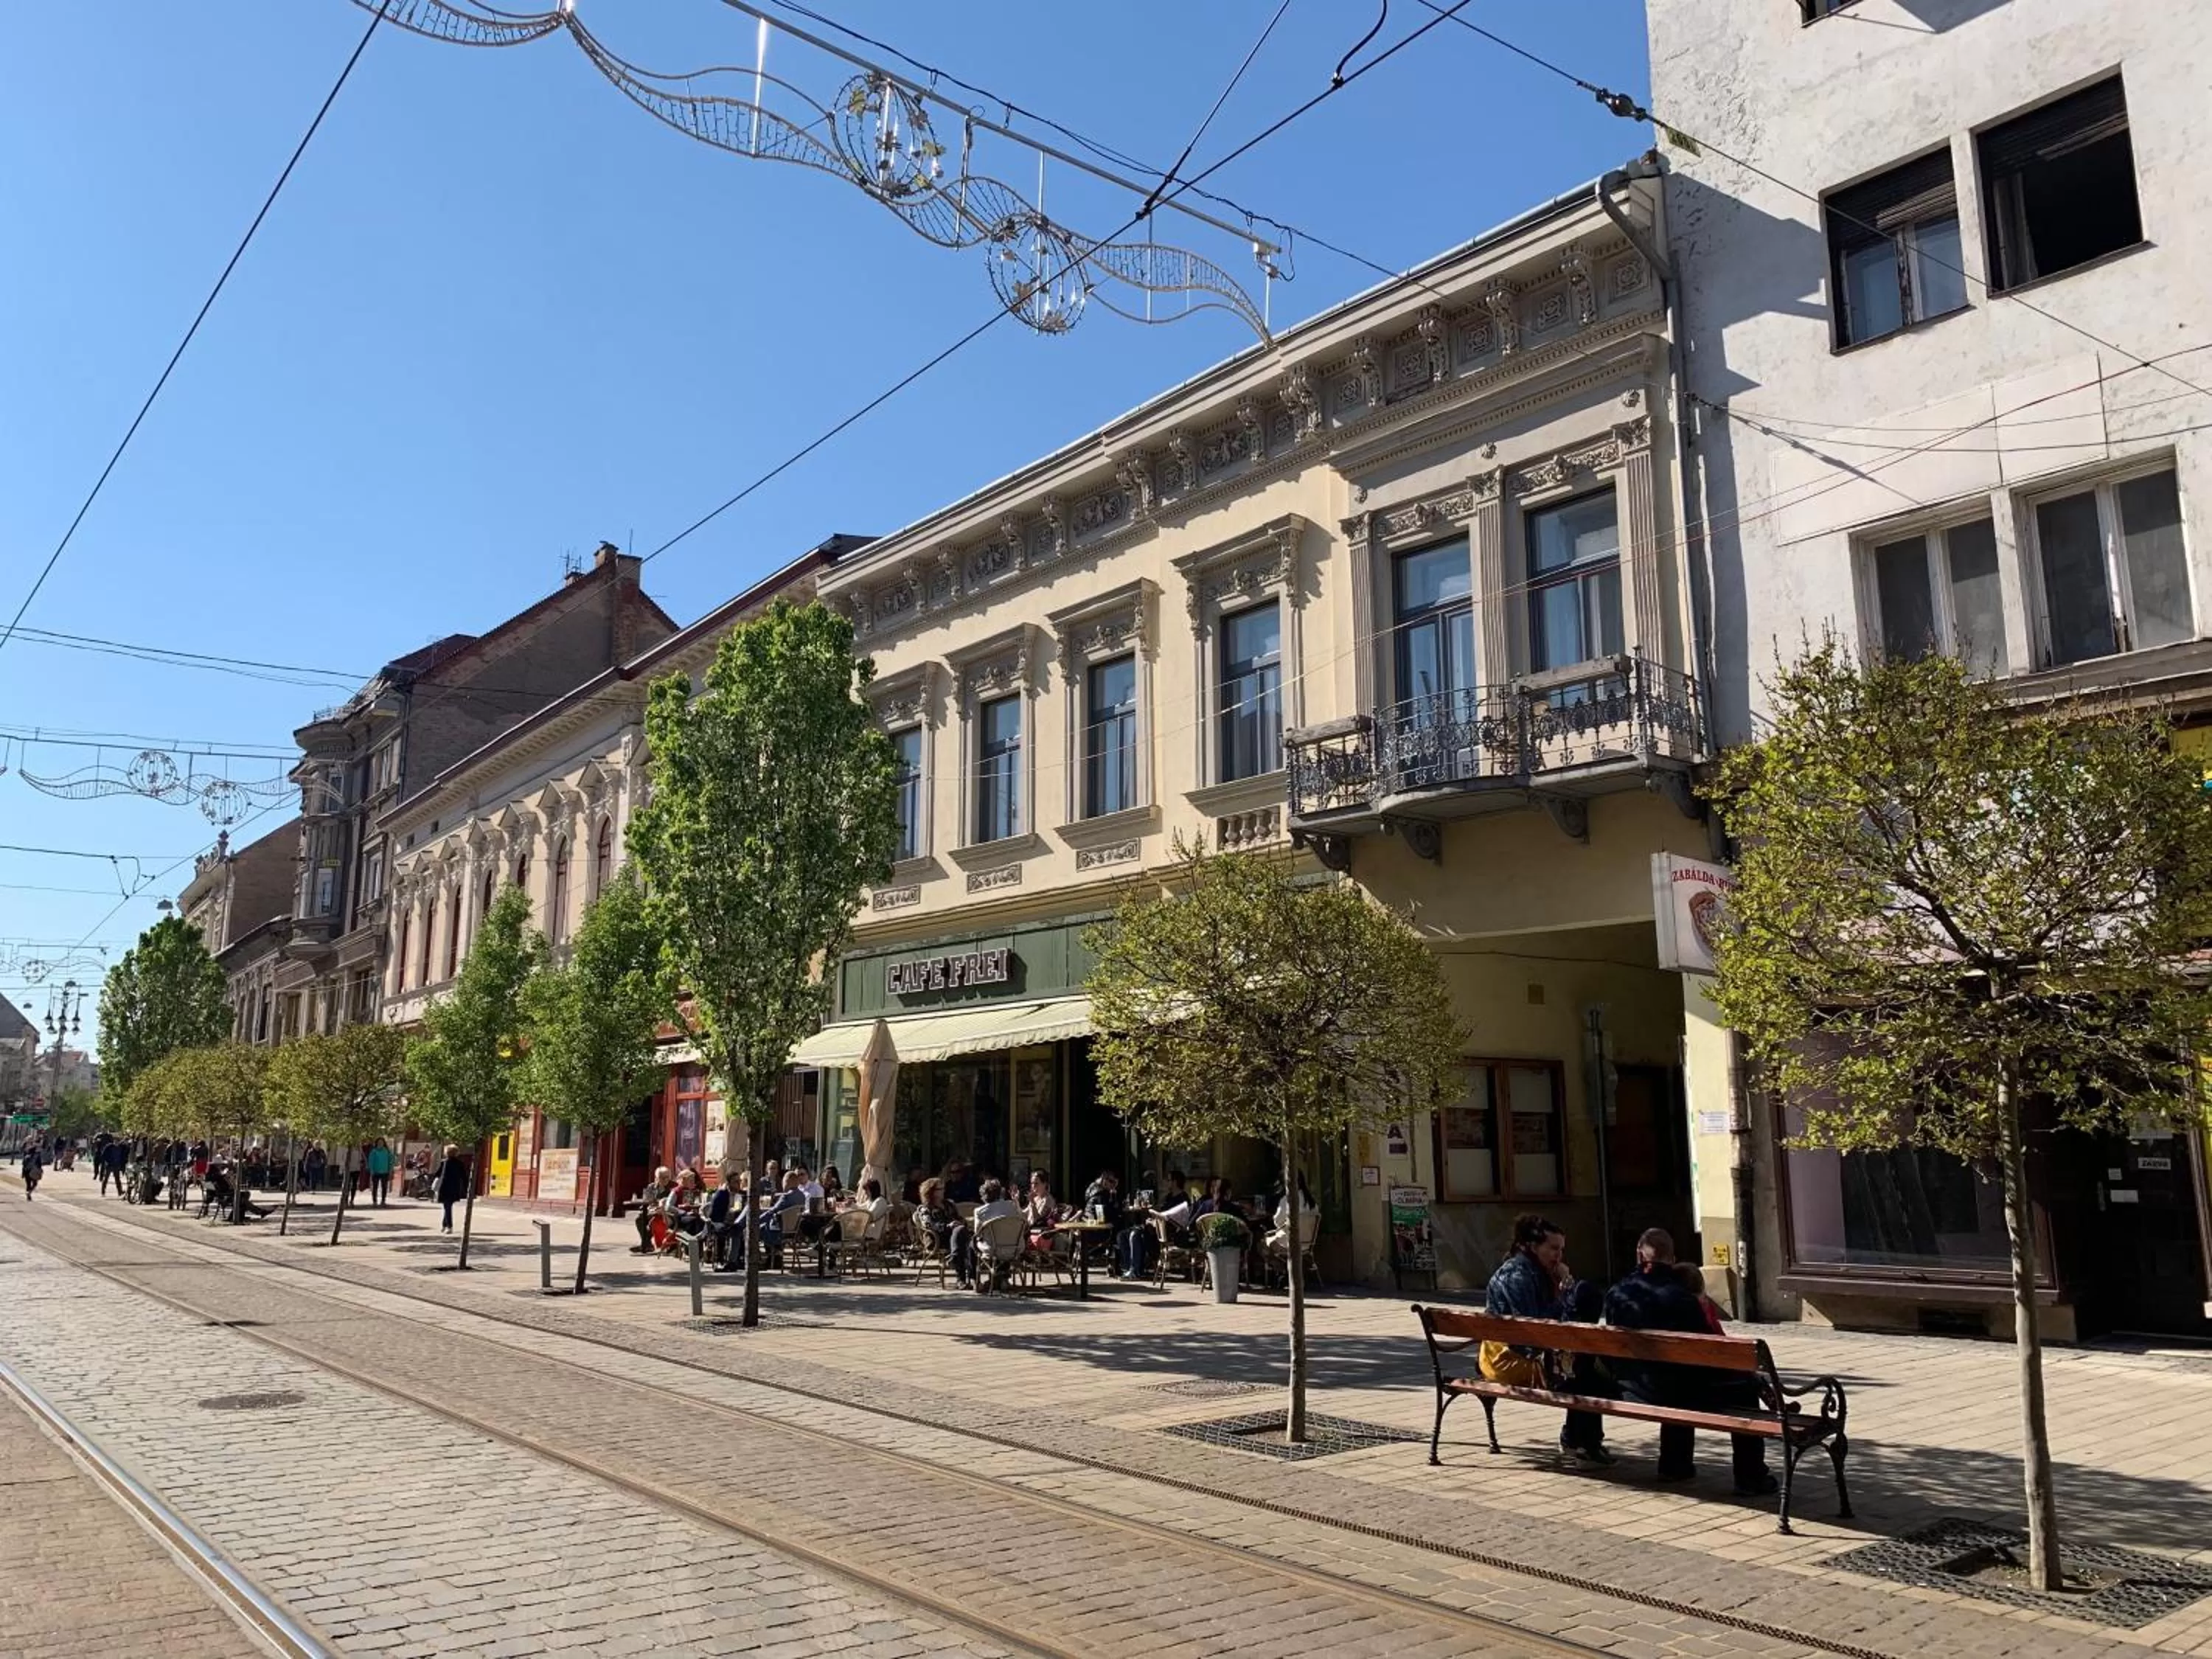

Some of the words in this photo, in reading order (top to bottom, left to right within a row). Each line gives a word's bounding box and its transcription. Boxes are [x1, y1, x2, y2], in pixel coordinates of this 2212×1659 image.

[1672, 866, 1716, 885] ZABÁLDA
[887, 957, 945, 995] CAFE
[948, 948, 1009, 987] FREI
